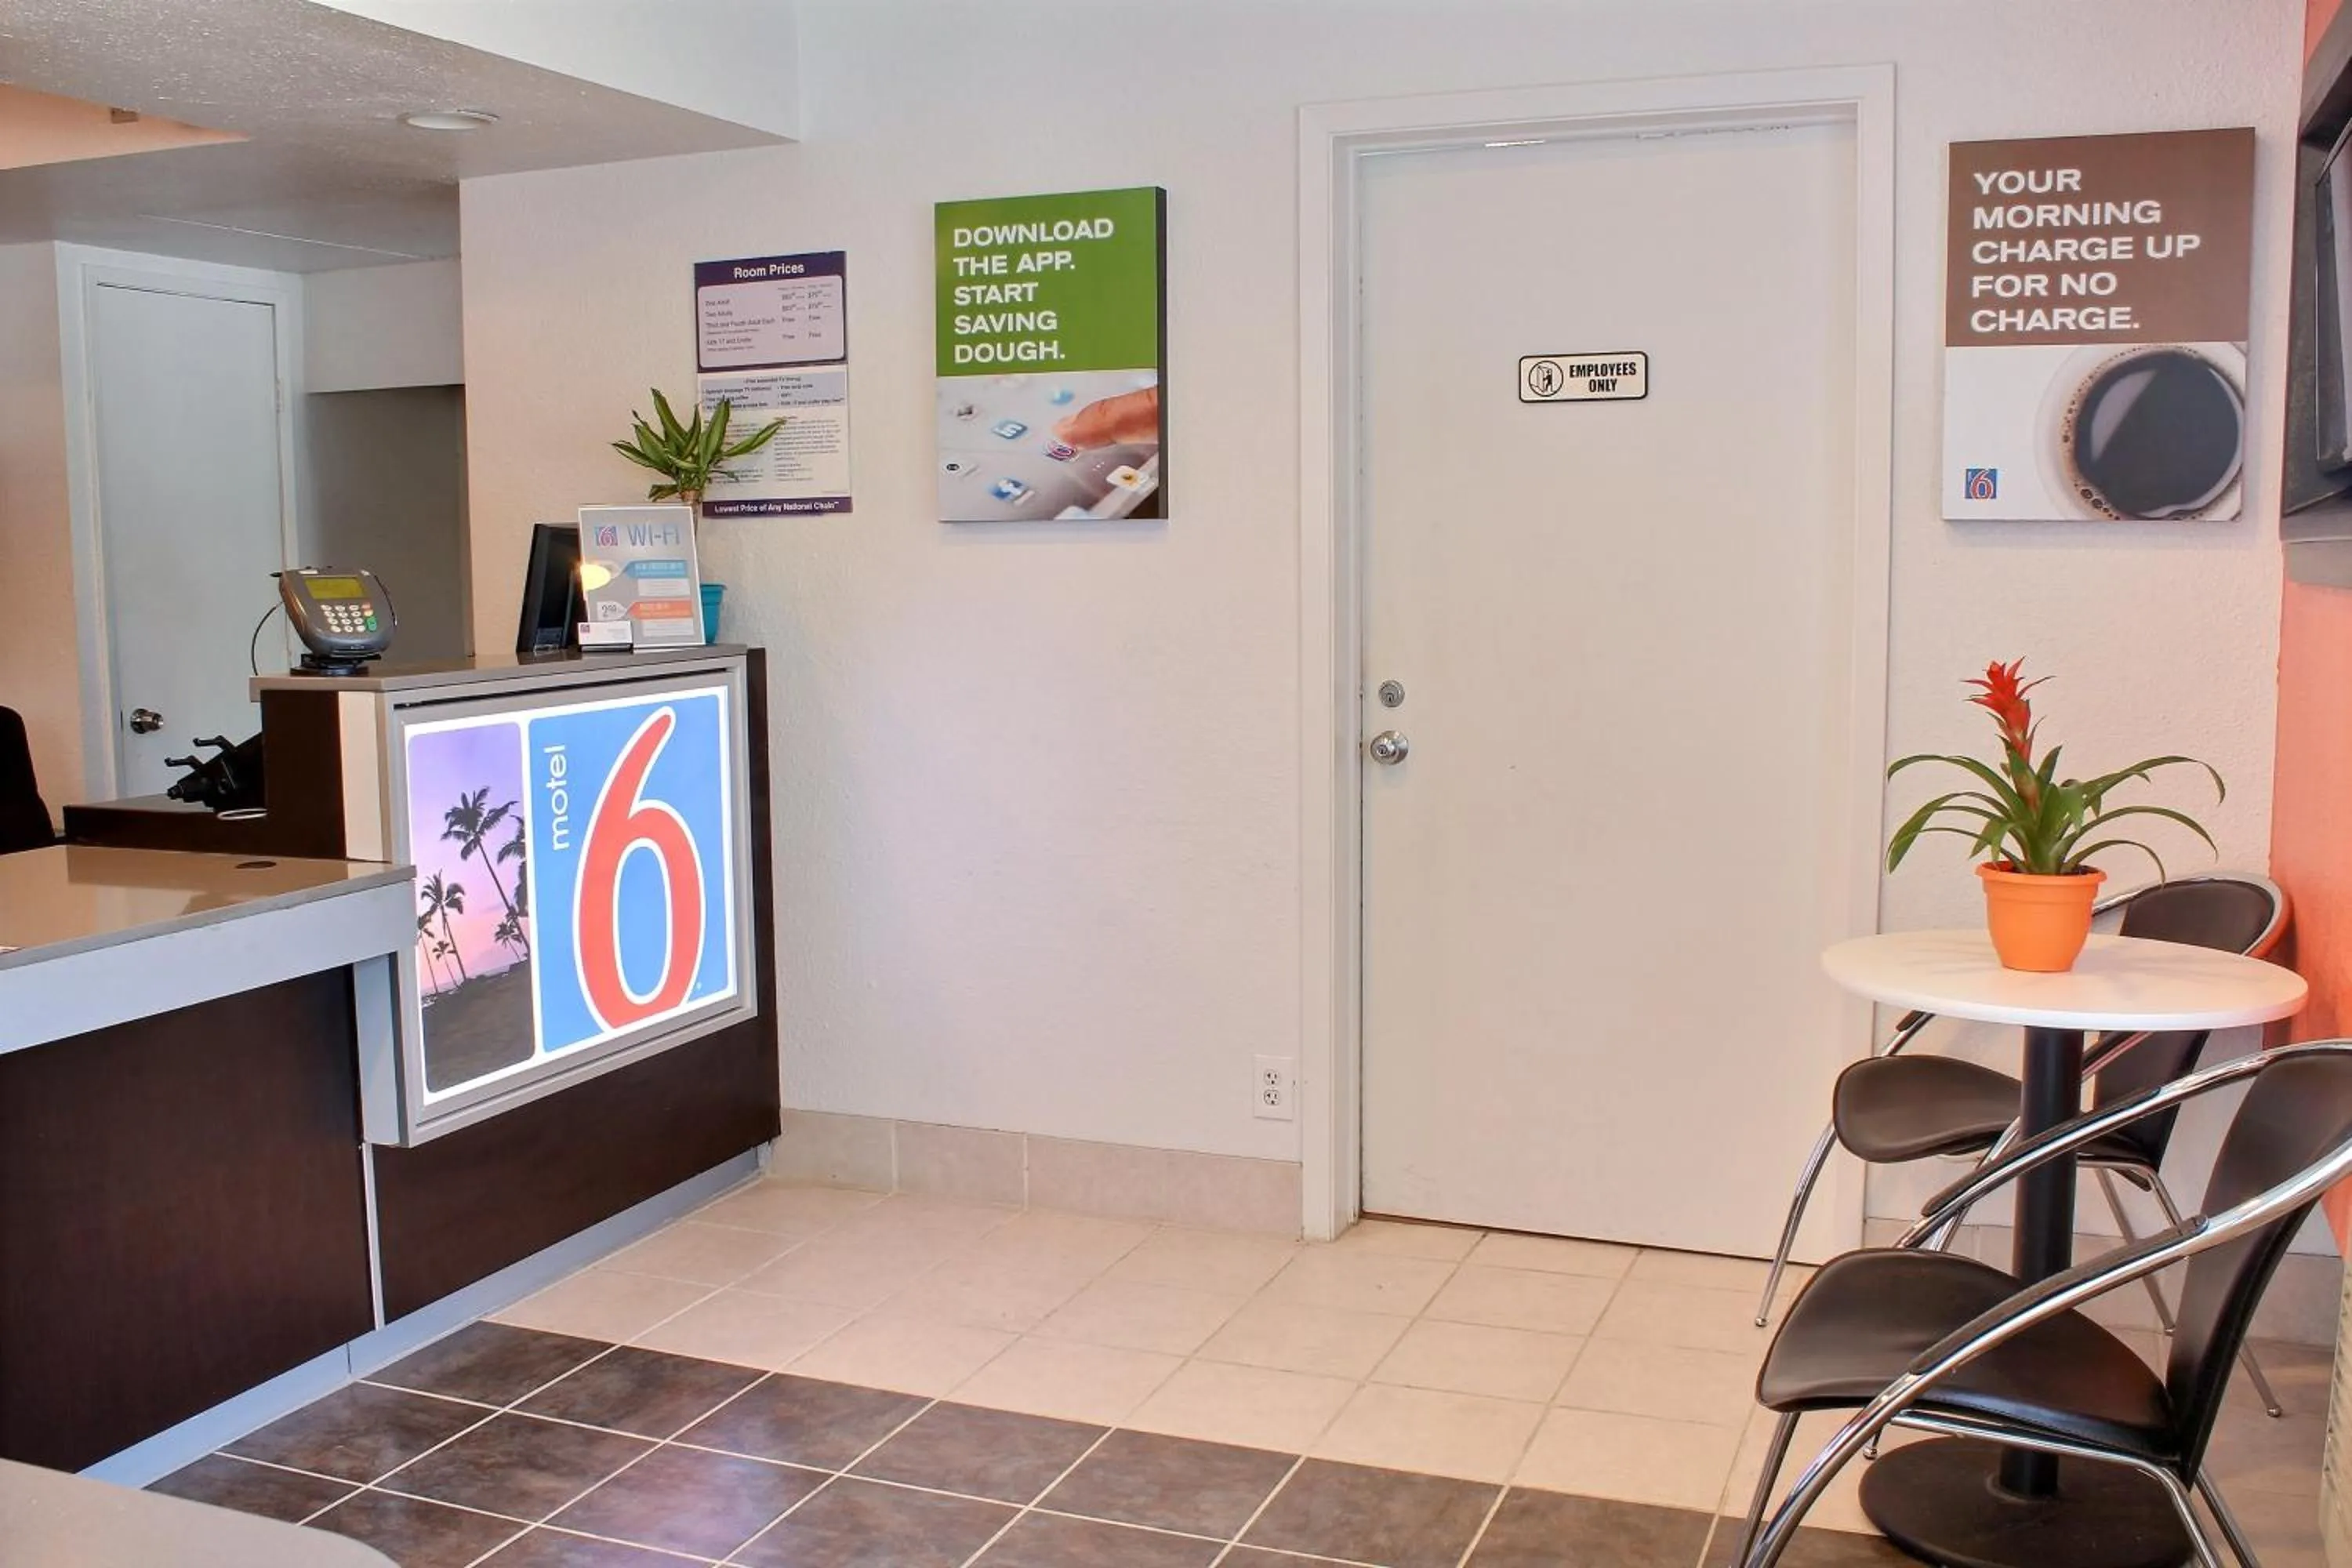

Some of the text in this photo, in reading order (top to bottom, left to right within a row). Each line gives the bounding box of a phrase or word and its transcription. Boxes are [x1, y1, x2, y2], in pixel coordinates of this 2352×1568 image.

[1973, 169, 2082, 195] YOUR
[1972, 200, 2162, 230] MORNING
[953, 218, 1114, 248] DOWNLOAD
[1971, 234, 2201, 264] CHARGE UP
[733, 263, 805, 279] Room Prices
[953, 251, 1076, 277] THE APP.
[953, 281, 1039, 306] START
[1971, 272, 2118, 298] FOR NO
[953, 310, 1058, 335] SAVING
[1970, 307, 2140, 334] CHARGE.
[953, 341, 1065, 364] DOUGH.
[1569, 362, 1636, 378] EMPLOYEES
[1589, 378, 1617, 393] ONLY
[1969, 468, 1994, 500] 6
[714, 504, 739, 514] Lowest
[740, 503, 758, 513] Price
[759, 503, 768, 512] of
[768, 503, 782, 513] Any
[783, 502, 812, 511] National
[627, 523, 681, 547] WI-FI
[543, 744, 571, 851] motel
[572, 706, 706, 1034] 6
